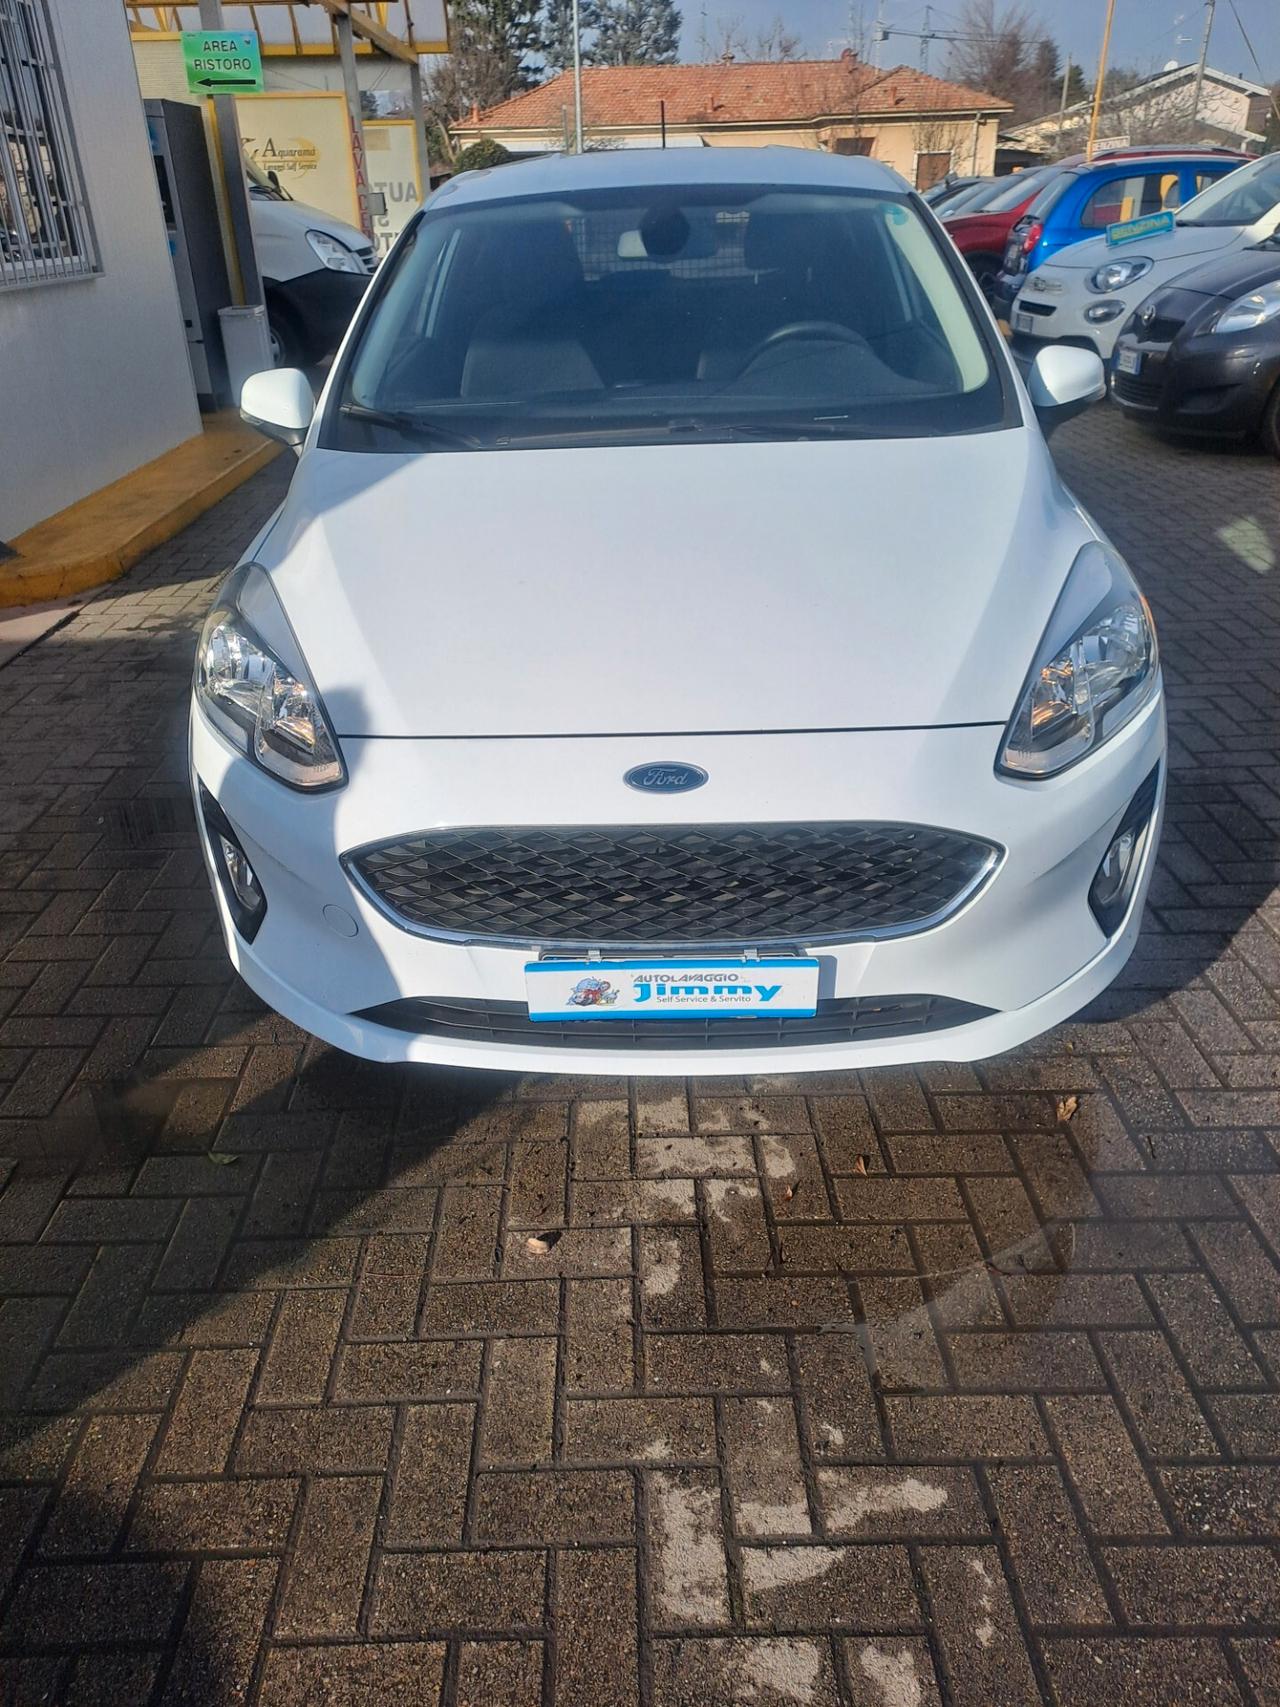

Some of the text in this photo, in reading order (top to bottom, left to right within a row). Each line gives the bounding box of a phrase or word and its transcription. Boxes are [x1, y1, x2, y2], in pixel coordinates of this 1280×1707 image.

[203, 40, 238, 52] AREA
[194, 58, 252, 70] RISTORO
[643, 768, 689, 786] Ford
[633, 973, 740, 983] AUTOLAVAGGIO
[633, 983, 783, 1002] Jimmy
[656, 995, 751, 1003] Self Service & Servito
